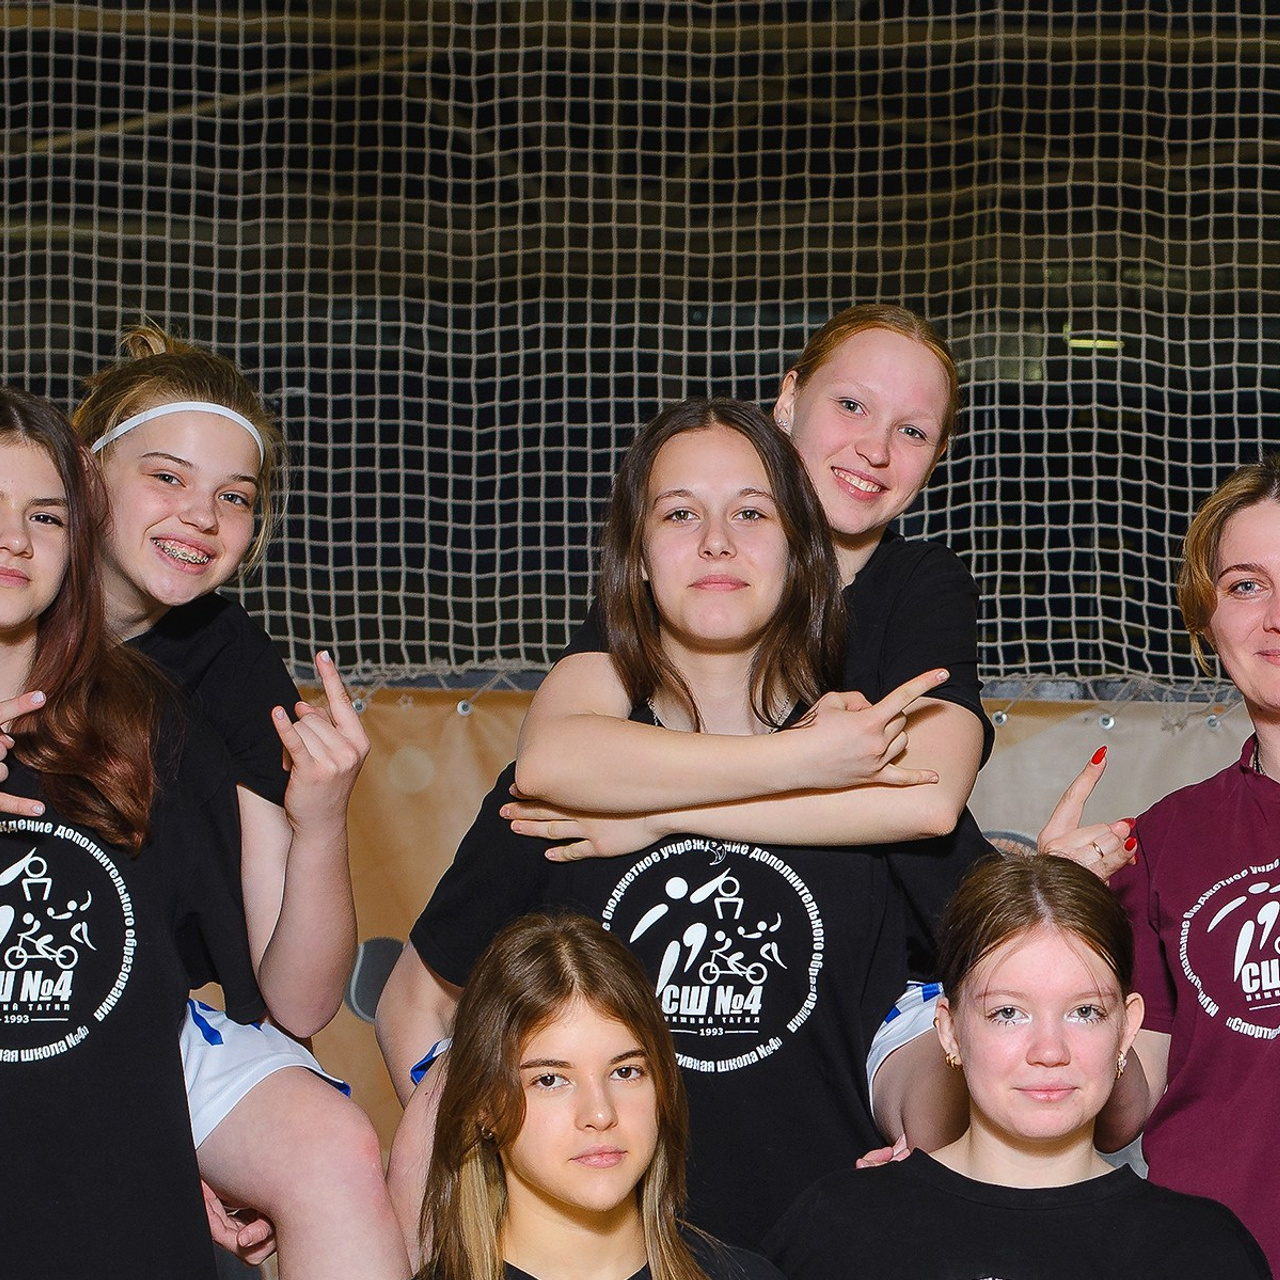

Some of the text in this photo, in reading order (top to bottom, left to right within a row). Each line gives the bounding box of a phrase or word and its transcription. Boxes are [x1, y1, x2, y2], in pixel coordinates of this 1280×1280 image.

[54, 825, 134, 926] дополнительного
[660, 839, 749, 860] учрежние
[749, 847, 825, 951] дополнительного
[93, 928, 137, 1022] образования
[662, 985, 710, 1015] СШ
[4, 1015, 29, 1024] 1993
[700, 1028, 723, 1036] 1993
[21, 1042, 67, 1063] школа
[717, 1050, 759, 1072] школа
